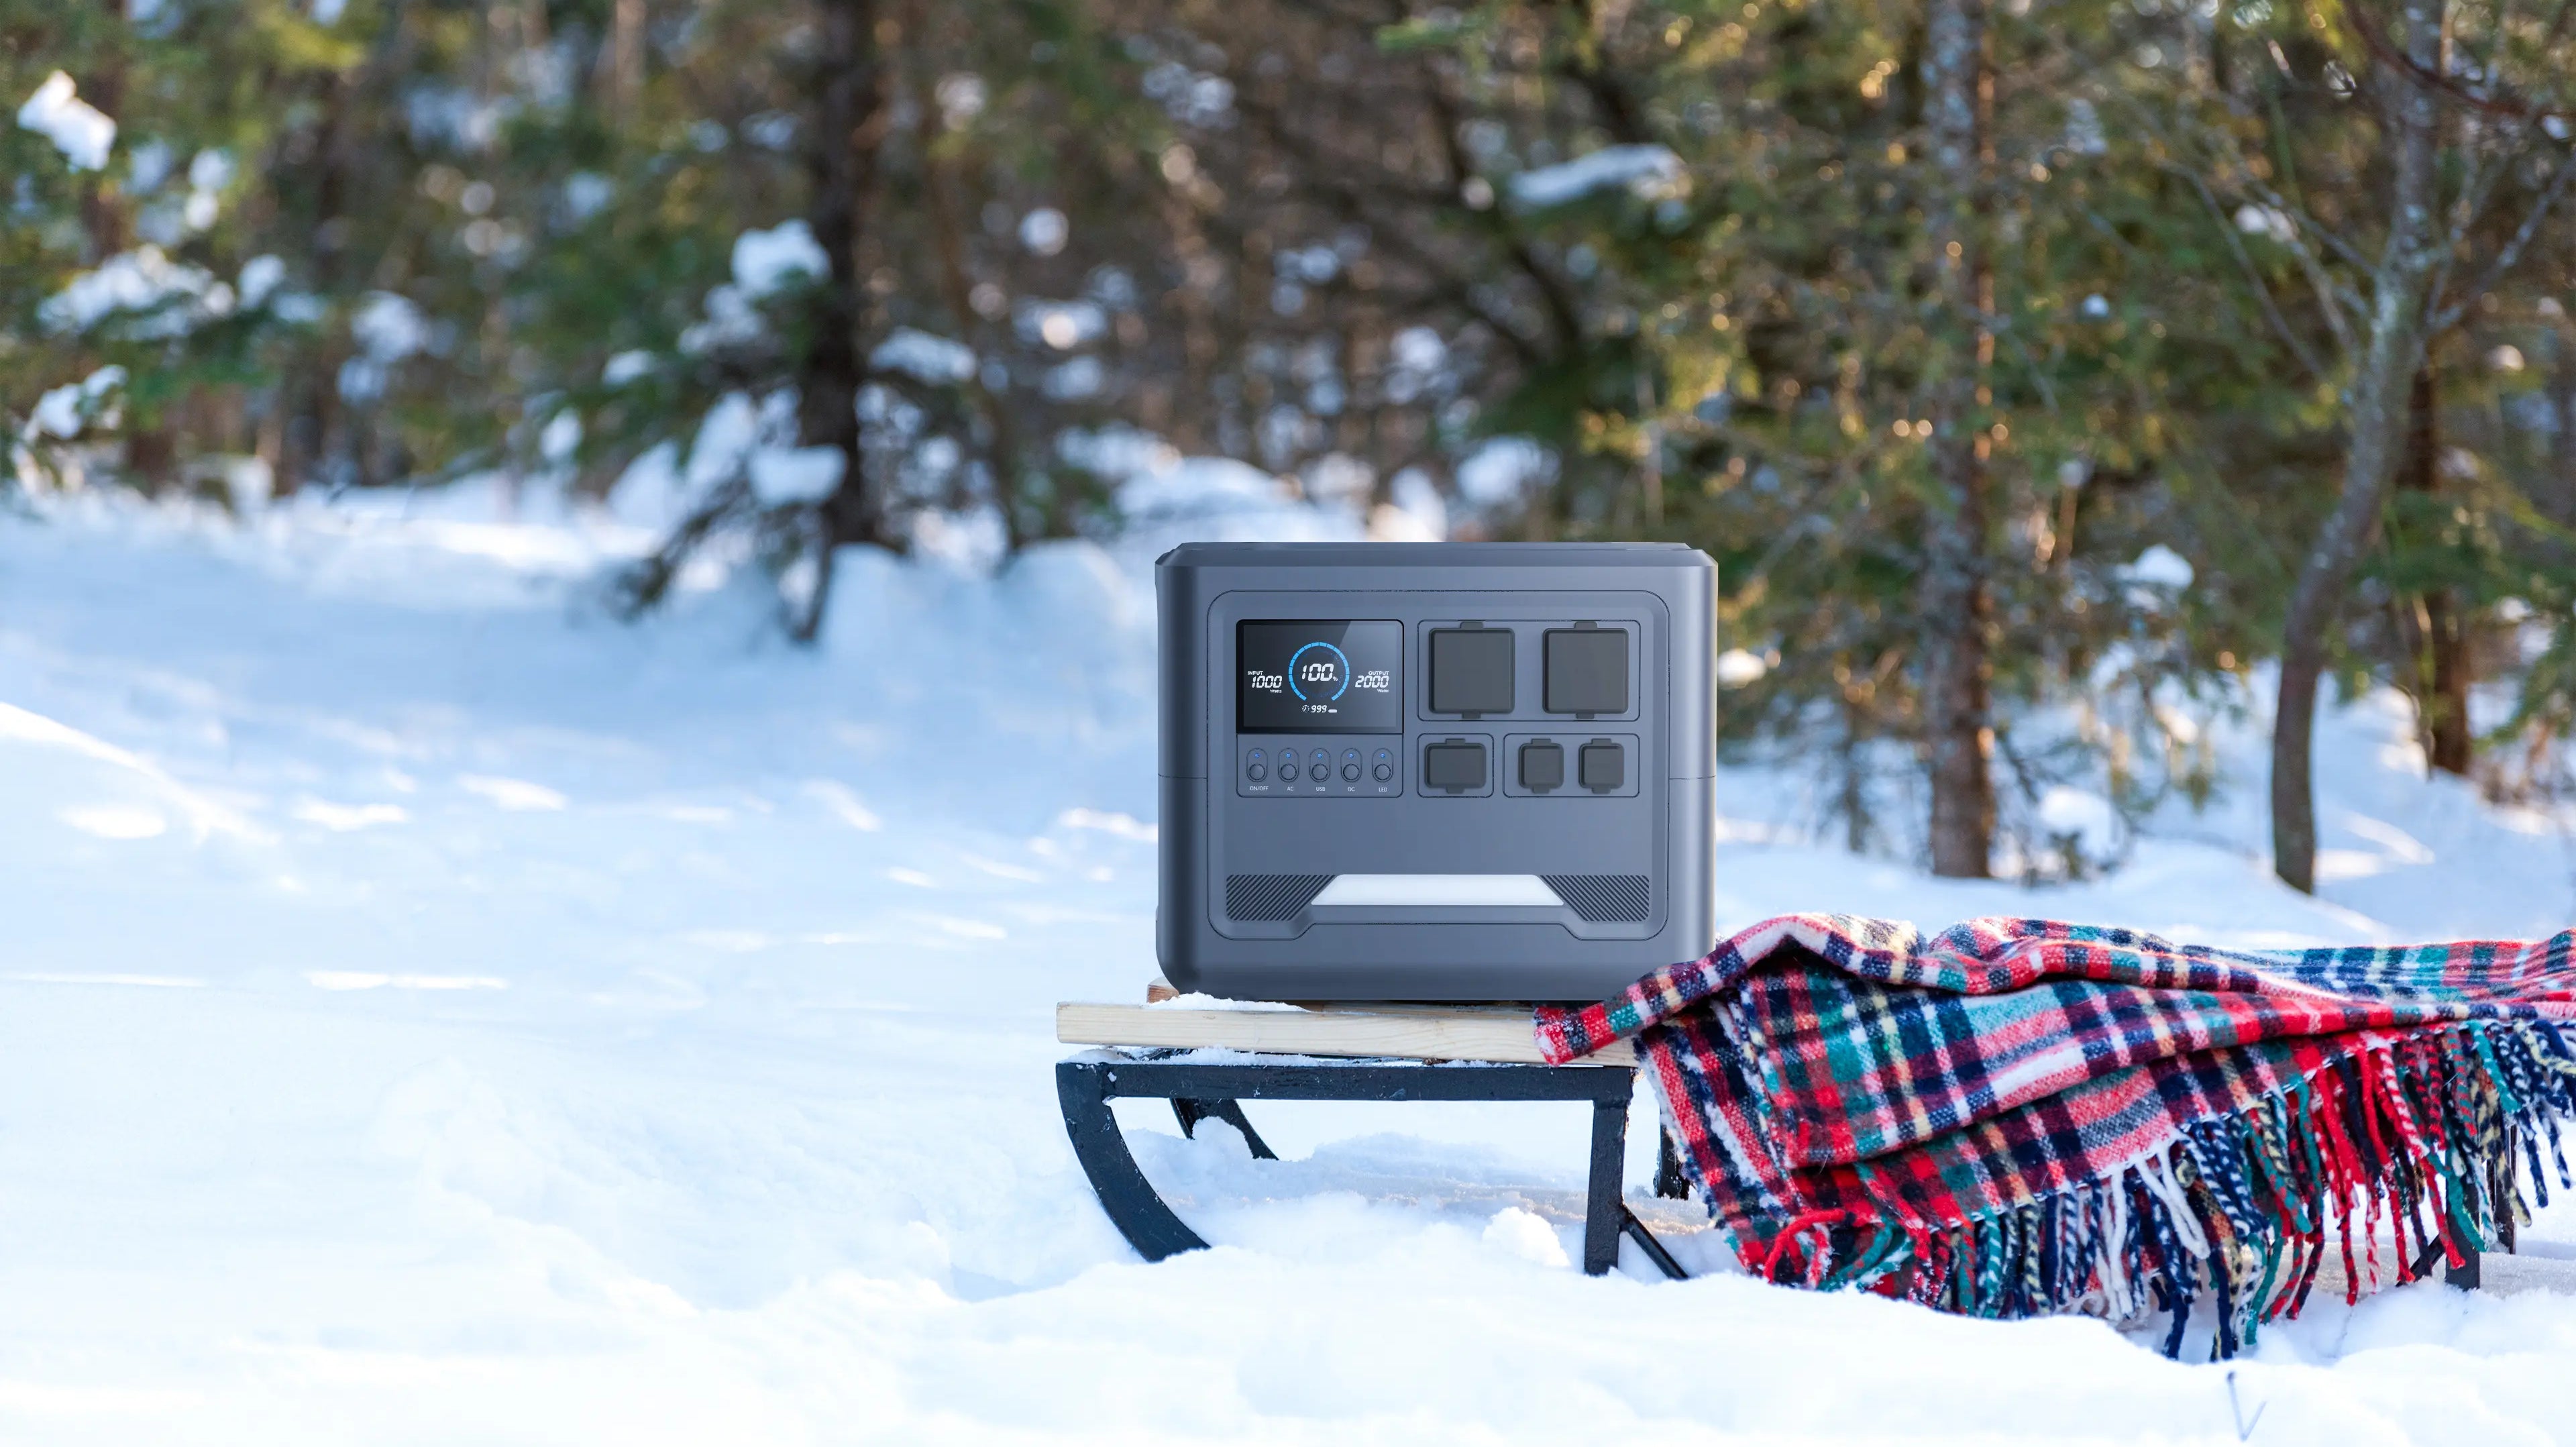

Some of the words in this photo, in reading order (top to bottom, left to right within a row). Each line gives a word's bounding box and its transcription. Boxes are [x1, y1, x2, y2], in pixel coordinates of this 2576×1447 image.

[1252, 676, 1283, 688] 1000
[1355, 675, 1389, 688] 2000
[1311, 704, 1328, 713] 999
